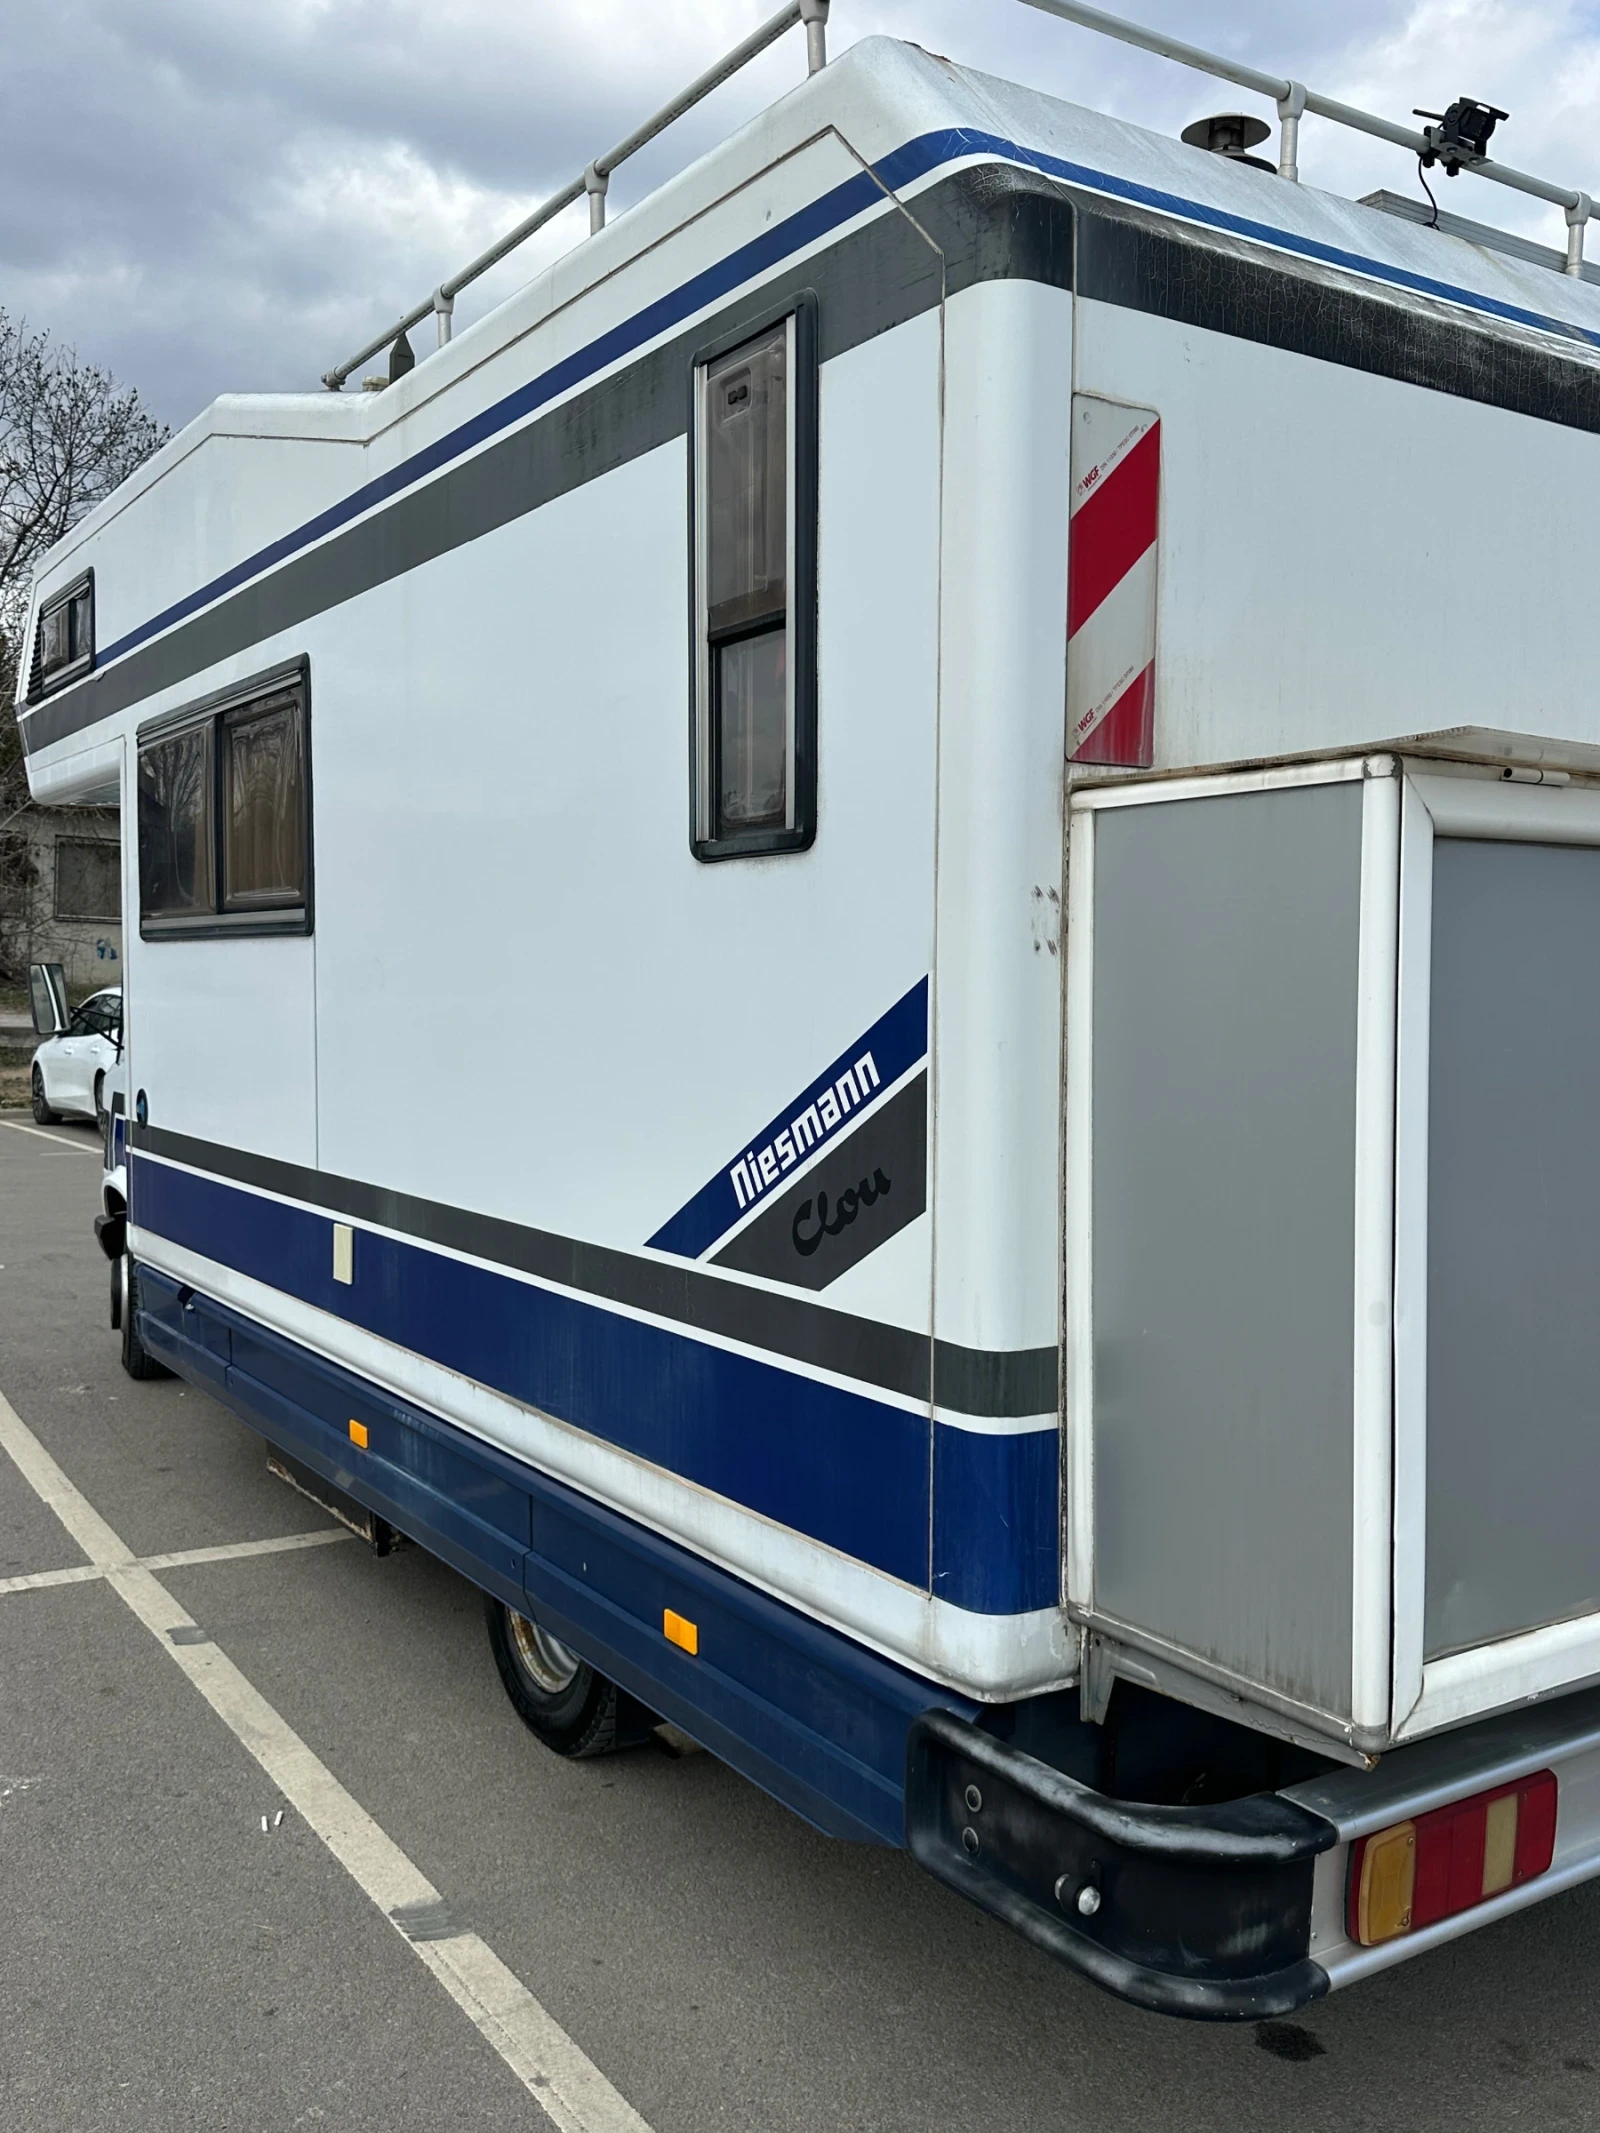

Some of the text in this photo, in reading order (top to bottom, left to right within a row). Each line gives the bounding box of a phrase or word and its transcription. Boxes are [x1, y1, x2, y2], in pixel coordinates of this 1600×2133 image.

[1082, 465, 1100, 488] WGF
[1077, 708, 1095, 731] WGF
[729, 1051, 881, 1210] Niesmann
[792, 1167, 892, 1256] Clou
